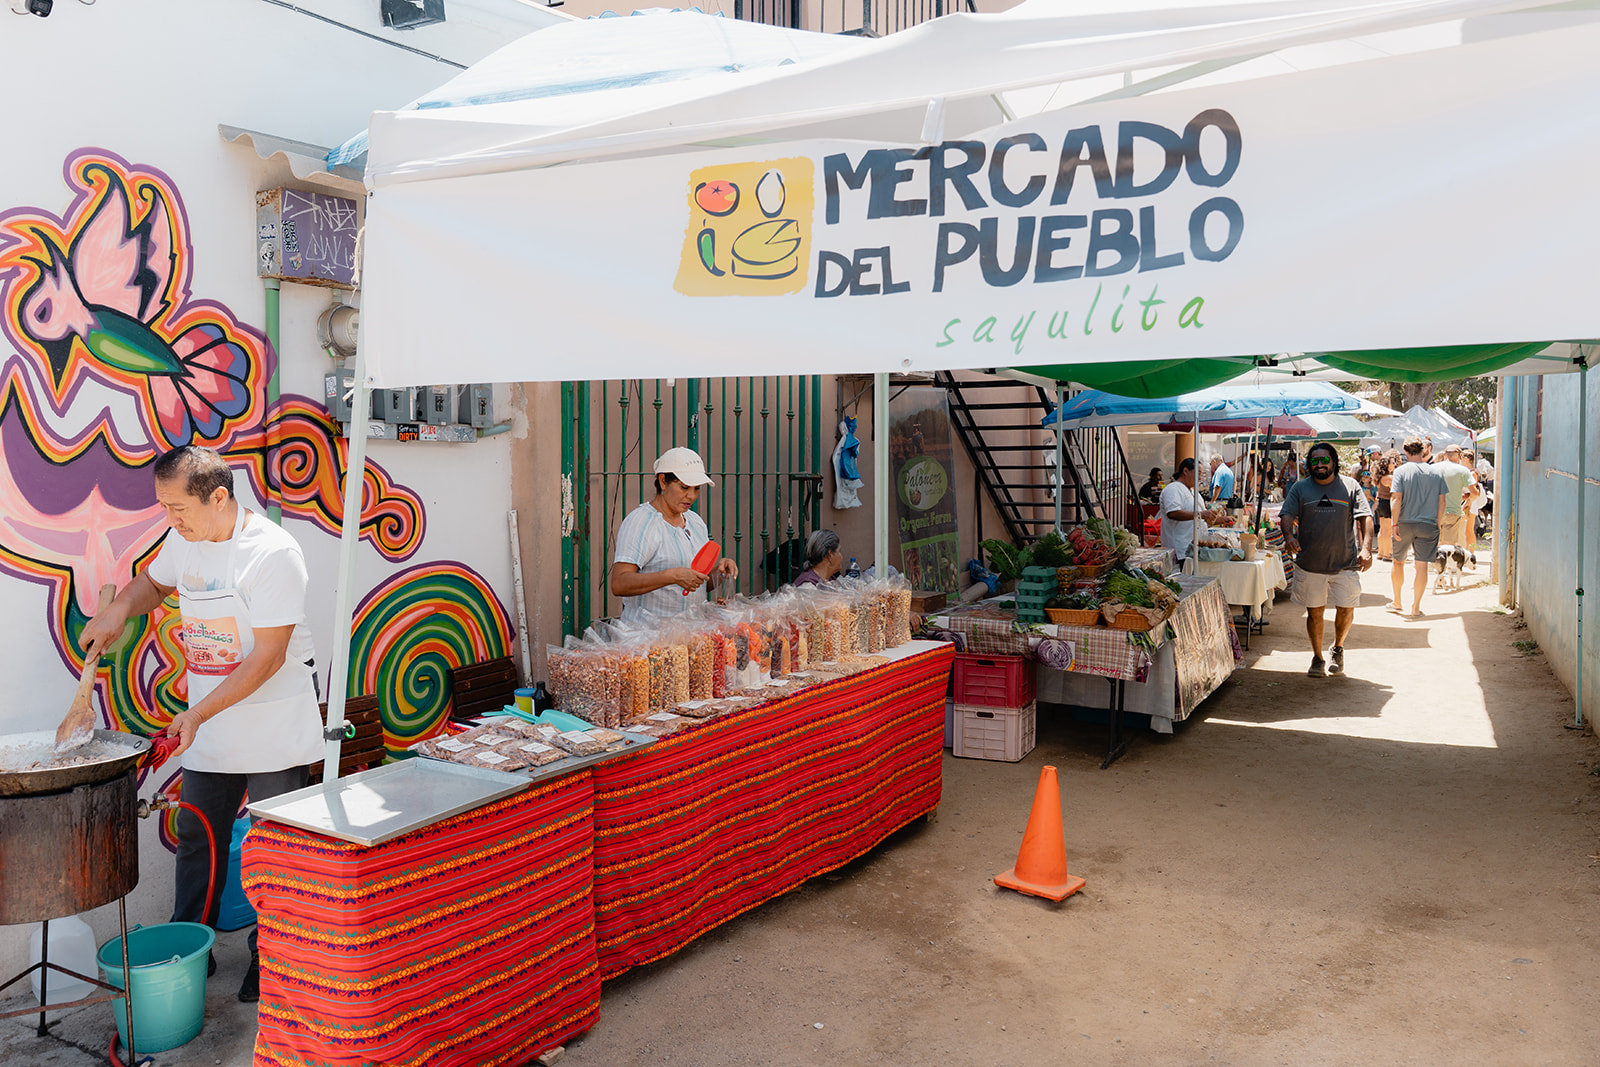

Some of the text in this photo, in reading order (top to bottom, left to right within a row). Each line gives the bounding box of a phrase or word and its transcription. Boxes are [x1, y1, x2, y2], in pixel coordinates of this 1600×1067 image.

[823, 108, 1242, 225] MERCADO
[814, 196, 1244, 298] DEL PUEBLO
[935, 281, 1206, 355] sayulita
[398, 432, 418, 440] DIRTY
[900, 511, 952, 534] Organic Farm
